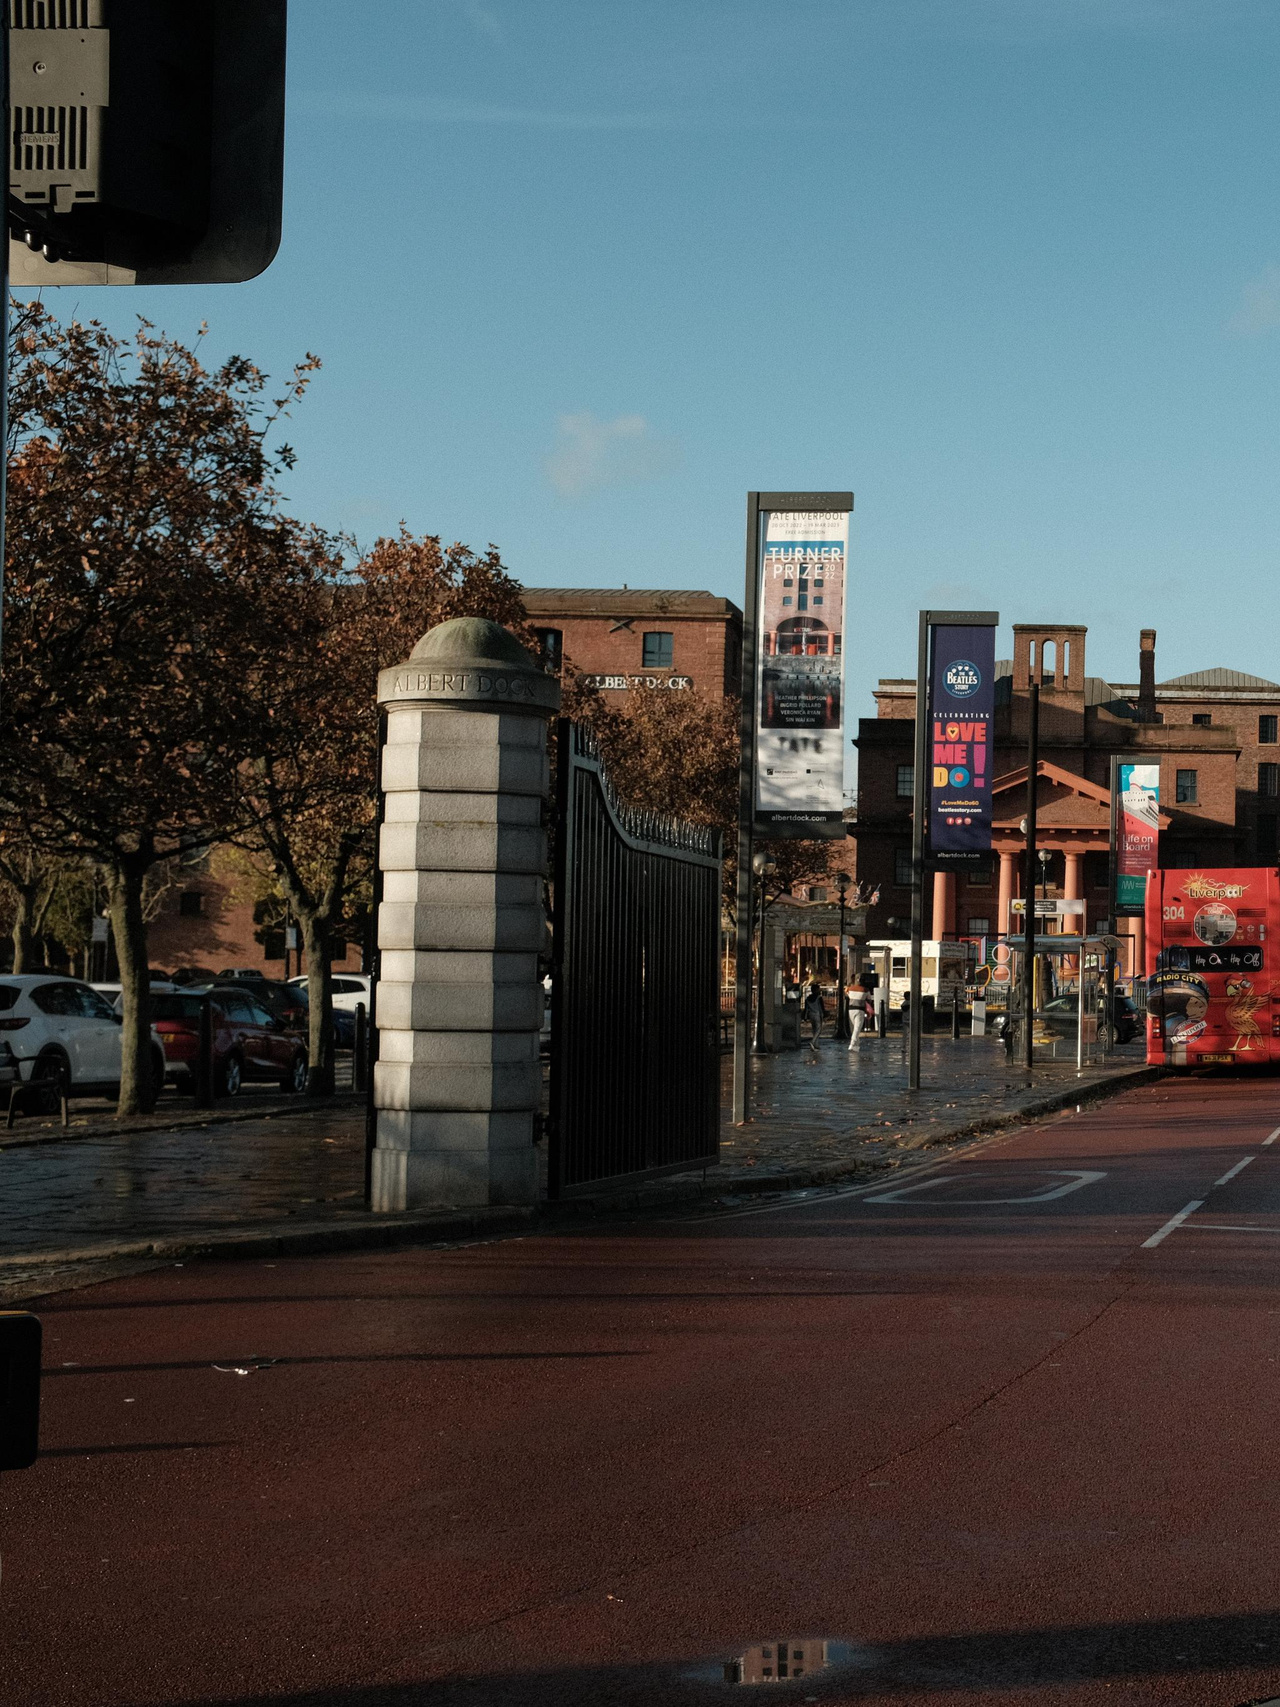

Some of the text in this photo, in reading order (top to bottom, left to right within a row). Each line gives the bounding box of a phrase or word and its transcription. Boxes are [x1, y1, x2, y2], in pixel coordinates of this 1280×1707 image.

[769, 548, 841, 562] TURNER
[774, 564, 822, 579] PRIZE
[947, 672, 977, 684] BEATLES
[393, 674, 535, 697] ALBERT DOCK
[934, 722, 986, 742] LOVE
[934, 744, 967, 764] ME
[934, 767, 970, 788] DO
[1123, 834, 1139, 842] Life
[1123, 843, 1150, 851] Board
[1190, 886, 1242, 899] Liverpool
[1163, 906, 1184, 920] 304
[1209, 953, 1222, 965] On
[1244, 953, 1260, 966] Off
[1157, 974, 1199, 984] RADIO CITY
